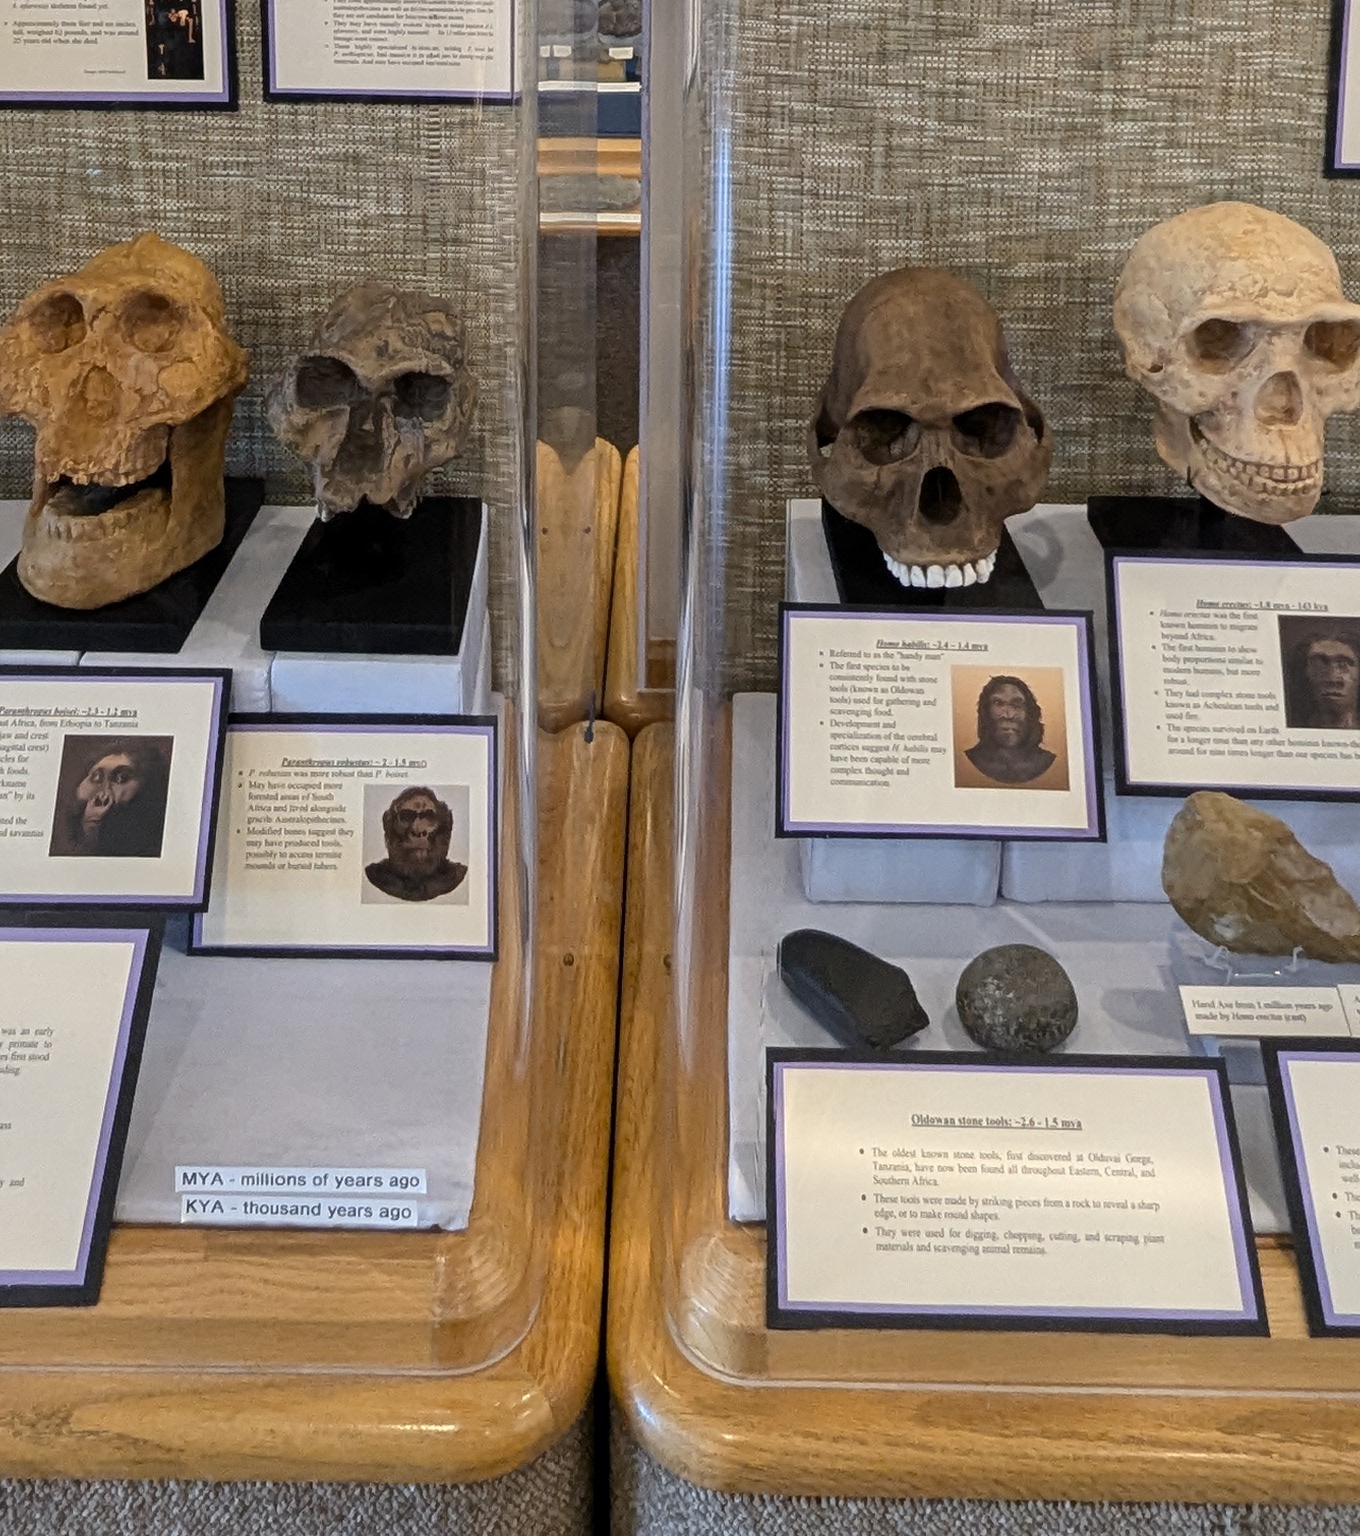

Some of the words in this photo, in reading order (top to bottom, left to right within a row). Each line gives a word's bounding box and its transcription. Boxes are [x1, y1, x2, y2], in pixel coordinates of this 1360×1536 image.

[39, 718, 58, 727] from
[912, 1113, 955, 1127] Oldowan
[958, 1116, 983, 1128] stone
[986, 1115, 1012, 1129] tools:
[1061, 1119, 1082, 1130] mya
[182, 1171, 223, 1185] MYA
[241, 1172, 306, 1185] millions
[312, 1172, 328, 1186] of
[335, 1175, 382, 1188] years
[389, 1175, 419, 1189] ago
[186, 1198, 223, 1213] KYA
[243, 1201, 321, 1215] thousand
[328, 1205, 372, 1219] years
[379, 1206, 411, 1220] ago
[873, 1192, 898, 1203] These
[900, 1194, 920, 1204] tools
[922, 1196, 942, 1204] were
[968, 1194, 978, 1208] by
[981, 1195, 1013, 1208] striking
[1043, 1197, 1063, 1207] from
[1072, 1198, 1090, 1208] rock
[1092, 1199, 1101, 1208] to
[1137, 1199, 1160, 1212] sharp
